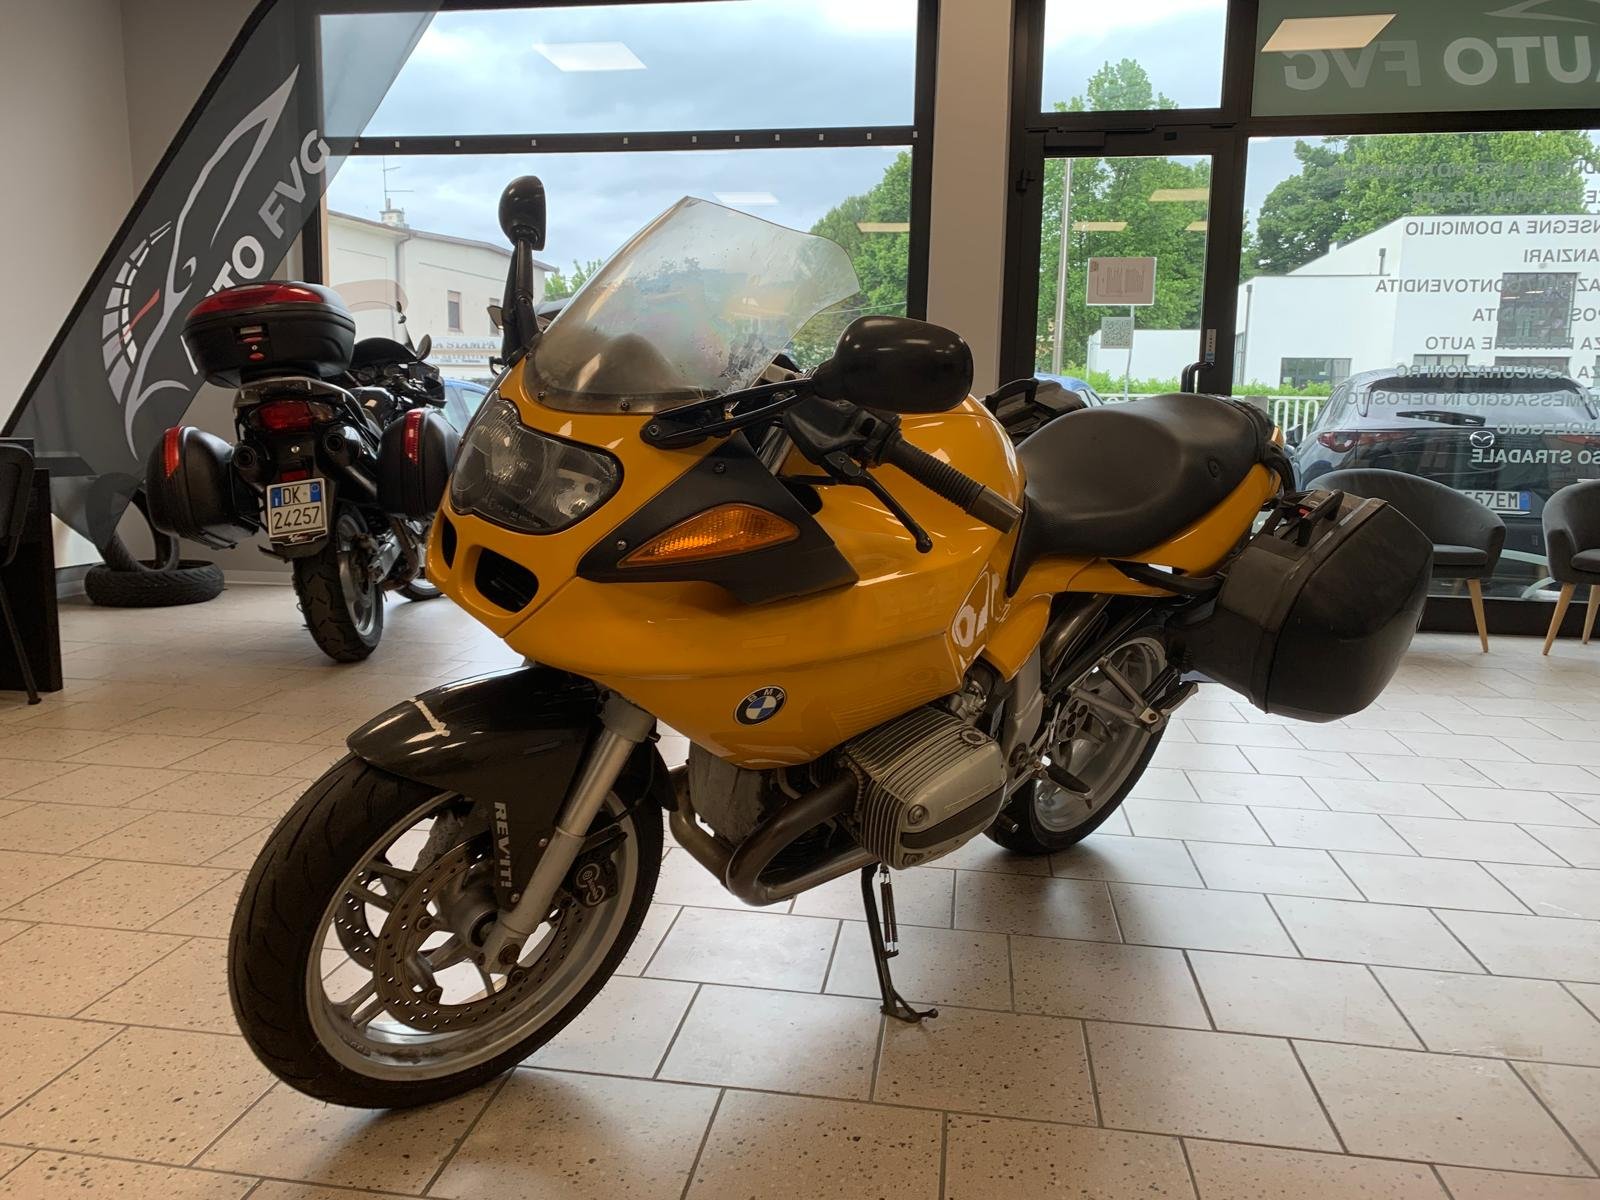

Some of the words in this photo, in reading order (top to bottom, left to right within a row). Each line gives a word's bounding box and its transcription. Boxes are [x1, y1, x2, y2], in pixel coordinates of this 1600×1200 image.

[258, 129, 331, 239] FVG
[283, 486, 301, 505] DK
[1465, 491, 1518, 508] 57EM
[274, 506, 320, 530] 24257
[747, 688, 784, 703] BMW
